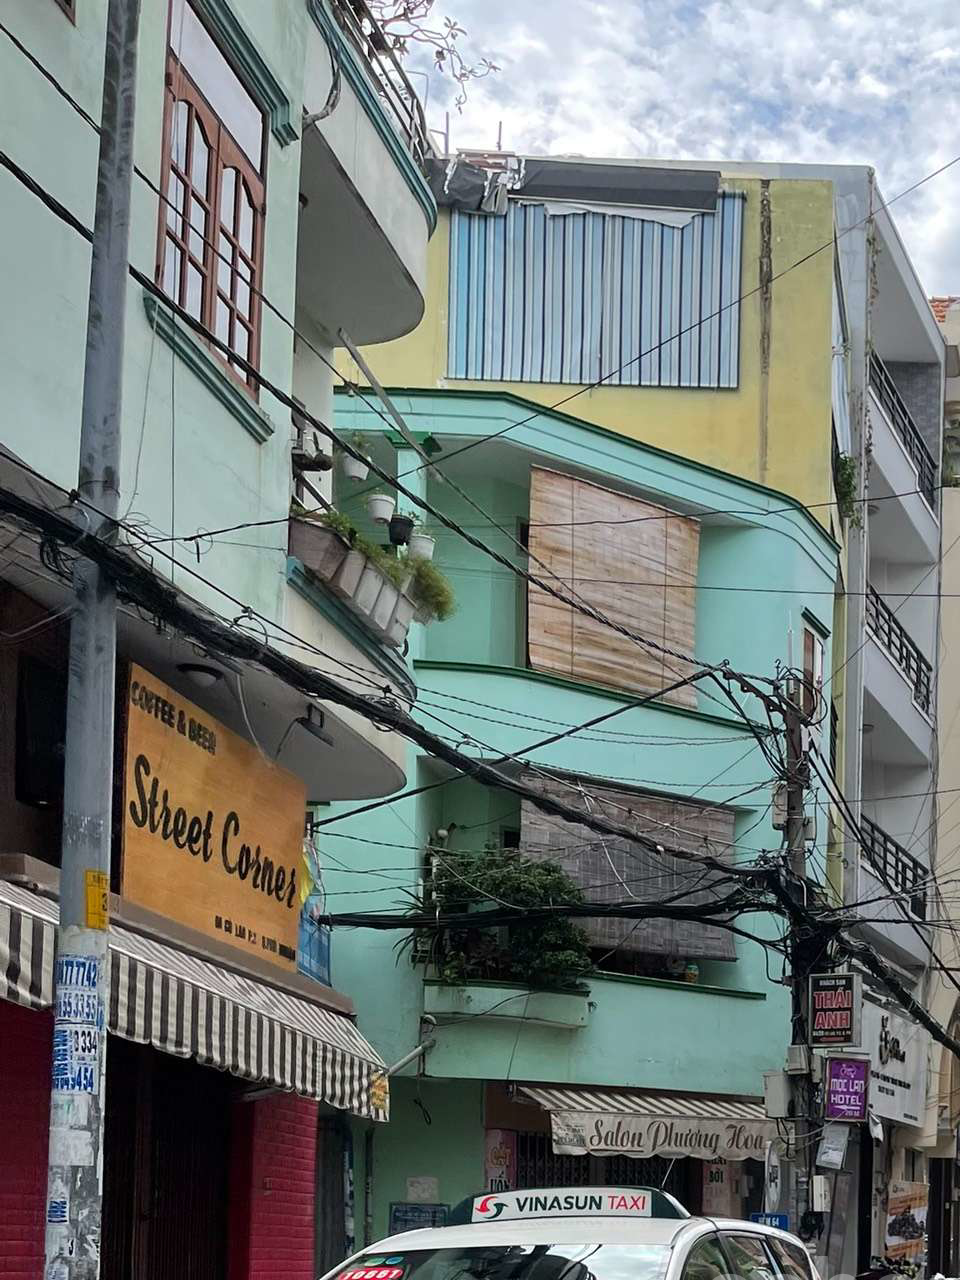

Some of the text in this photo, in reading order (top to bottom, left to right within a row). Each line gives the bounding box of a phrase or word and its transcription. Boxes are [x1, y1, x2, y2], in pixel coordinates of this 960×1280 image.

[129, 754, 214, 863] Street
[221, 811, 297, 909] Corner
[813, 986, 852, 1009] THÁI
[815, 1010, 850, 1029] ANH
[831, 1094, 862, 1105] HOTEL
[589, 1119, 643, 1148] Salon
[646, 1120, 721, 1154] Phương
[725, 1123, 766, 1150] Hoa
[515, 1195, 646, 1212] VINASUN TAXI
